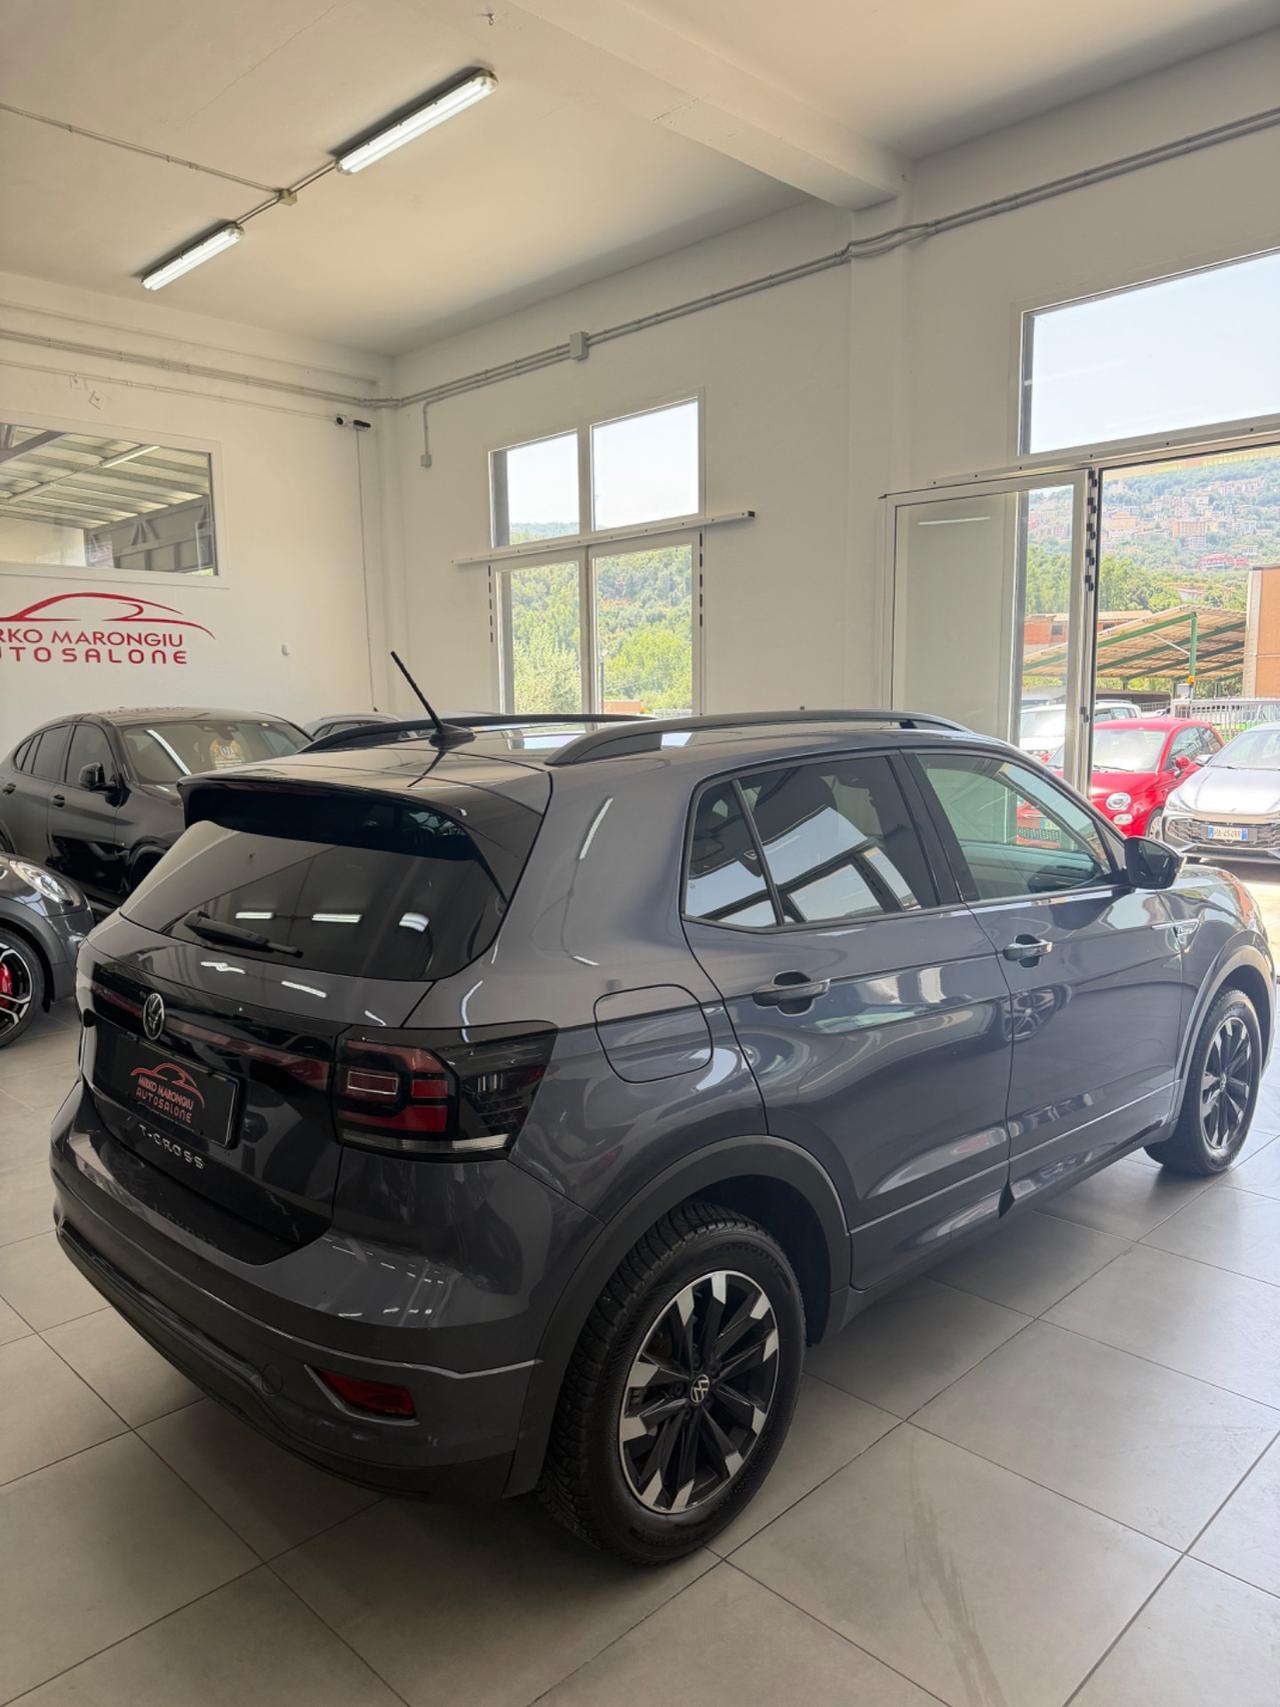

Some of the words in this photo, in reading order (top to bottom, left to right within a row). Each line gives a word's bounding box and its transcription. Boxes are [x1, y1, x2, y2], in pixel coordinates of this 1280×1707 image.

[51, 630, 183, 647] MARONGIU
[0, 646, 187, 664] TOSALONE
[136, 1087, 192, 1123] AUTOSALONE
[139, 1123, 205, 1169] T-CROSS
